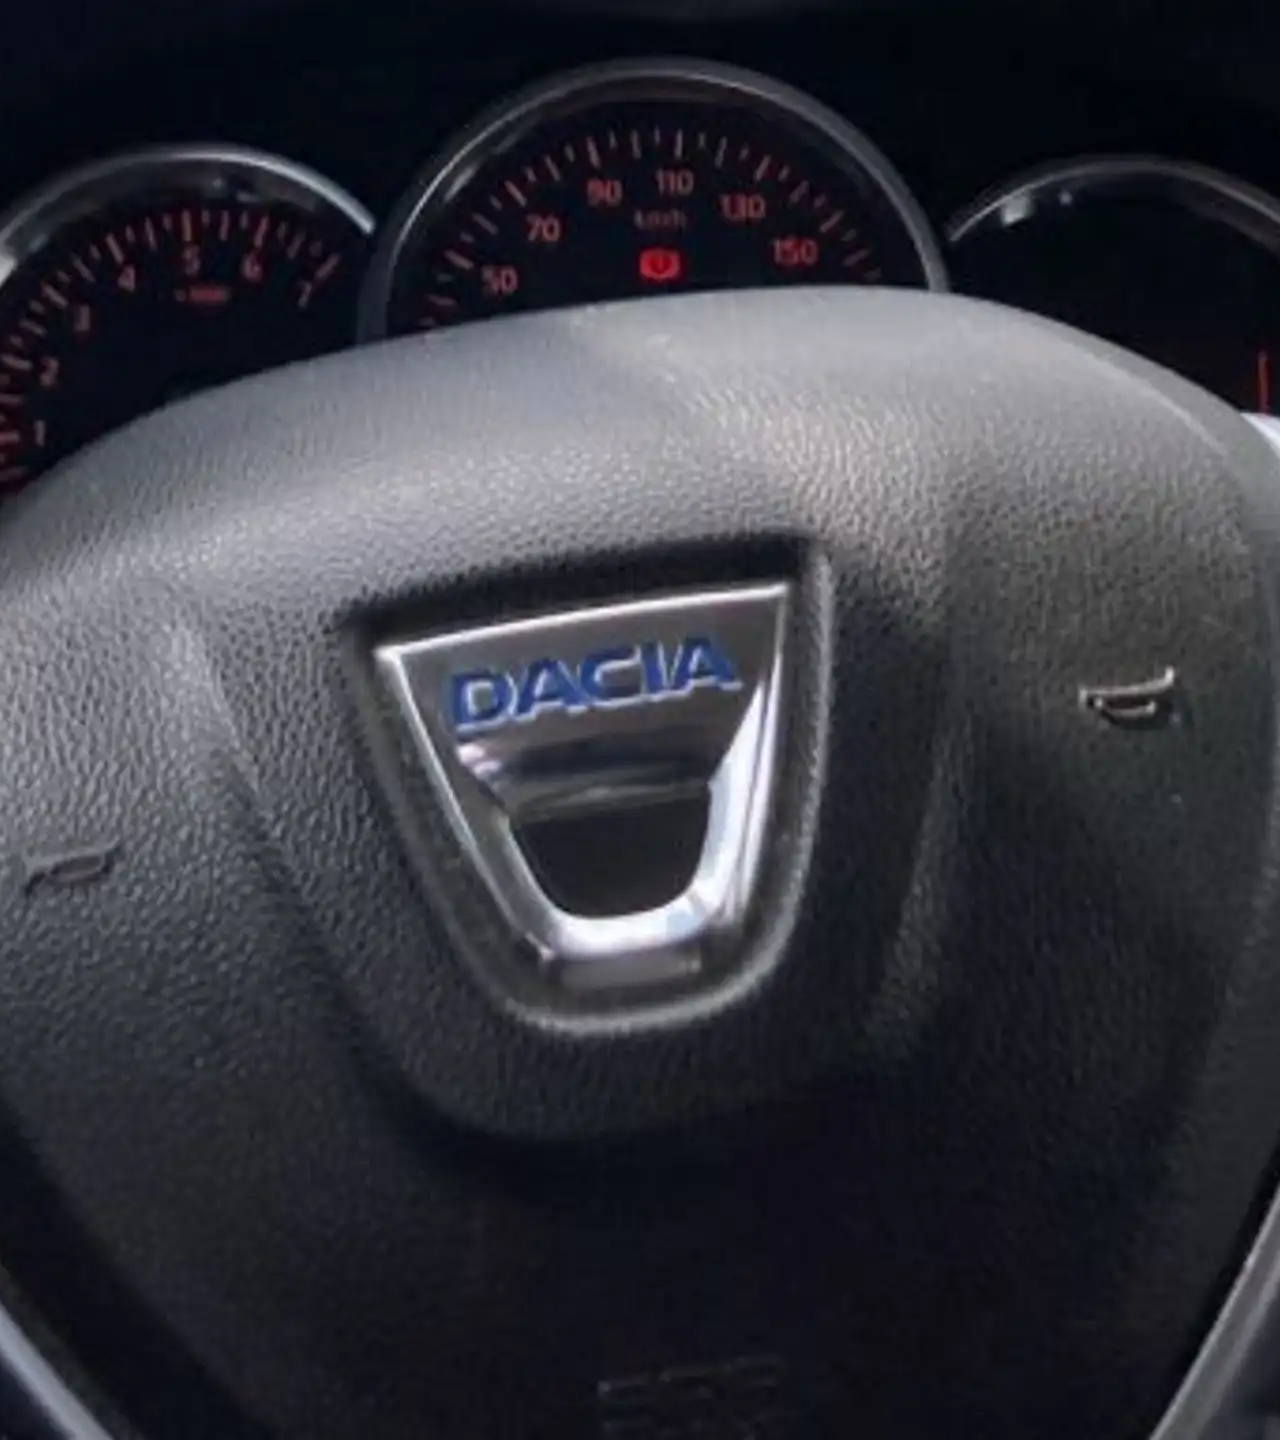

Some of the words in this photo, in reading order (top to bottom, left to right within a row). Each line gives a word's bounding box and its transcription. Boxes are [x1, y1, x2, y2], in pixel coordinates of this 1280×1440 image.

[655, 168, 694, 195] 110
[721, 194, 766, 221] 130
[526, 215, 561, 243] 70
[772, 238, 818, 267] 150
[481, 264, 519, 295] 50
[449, 636, 743, 734] DACIA
